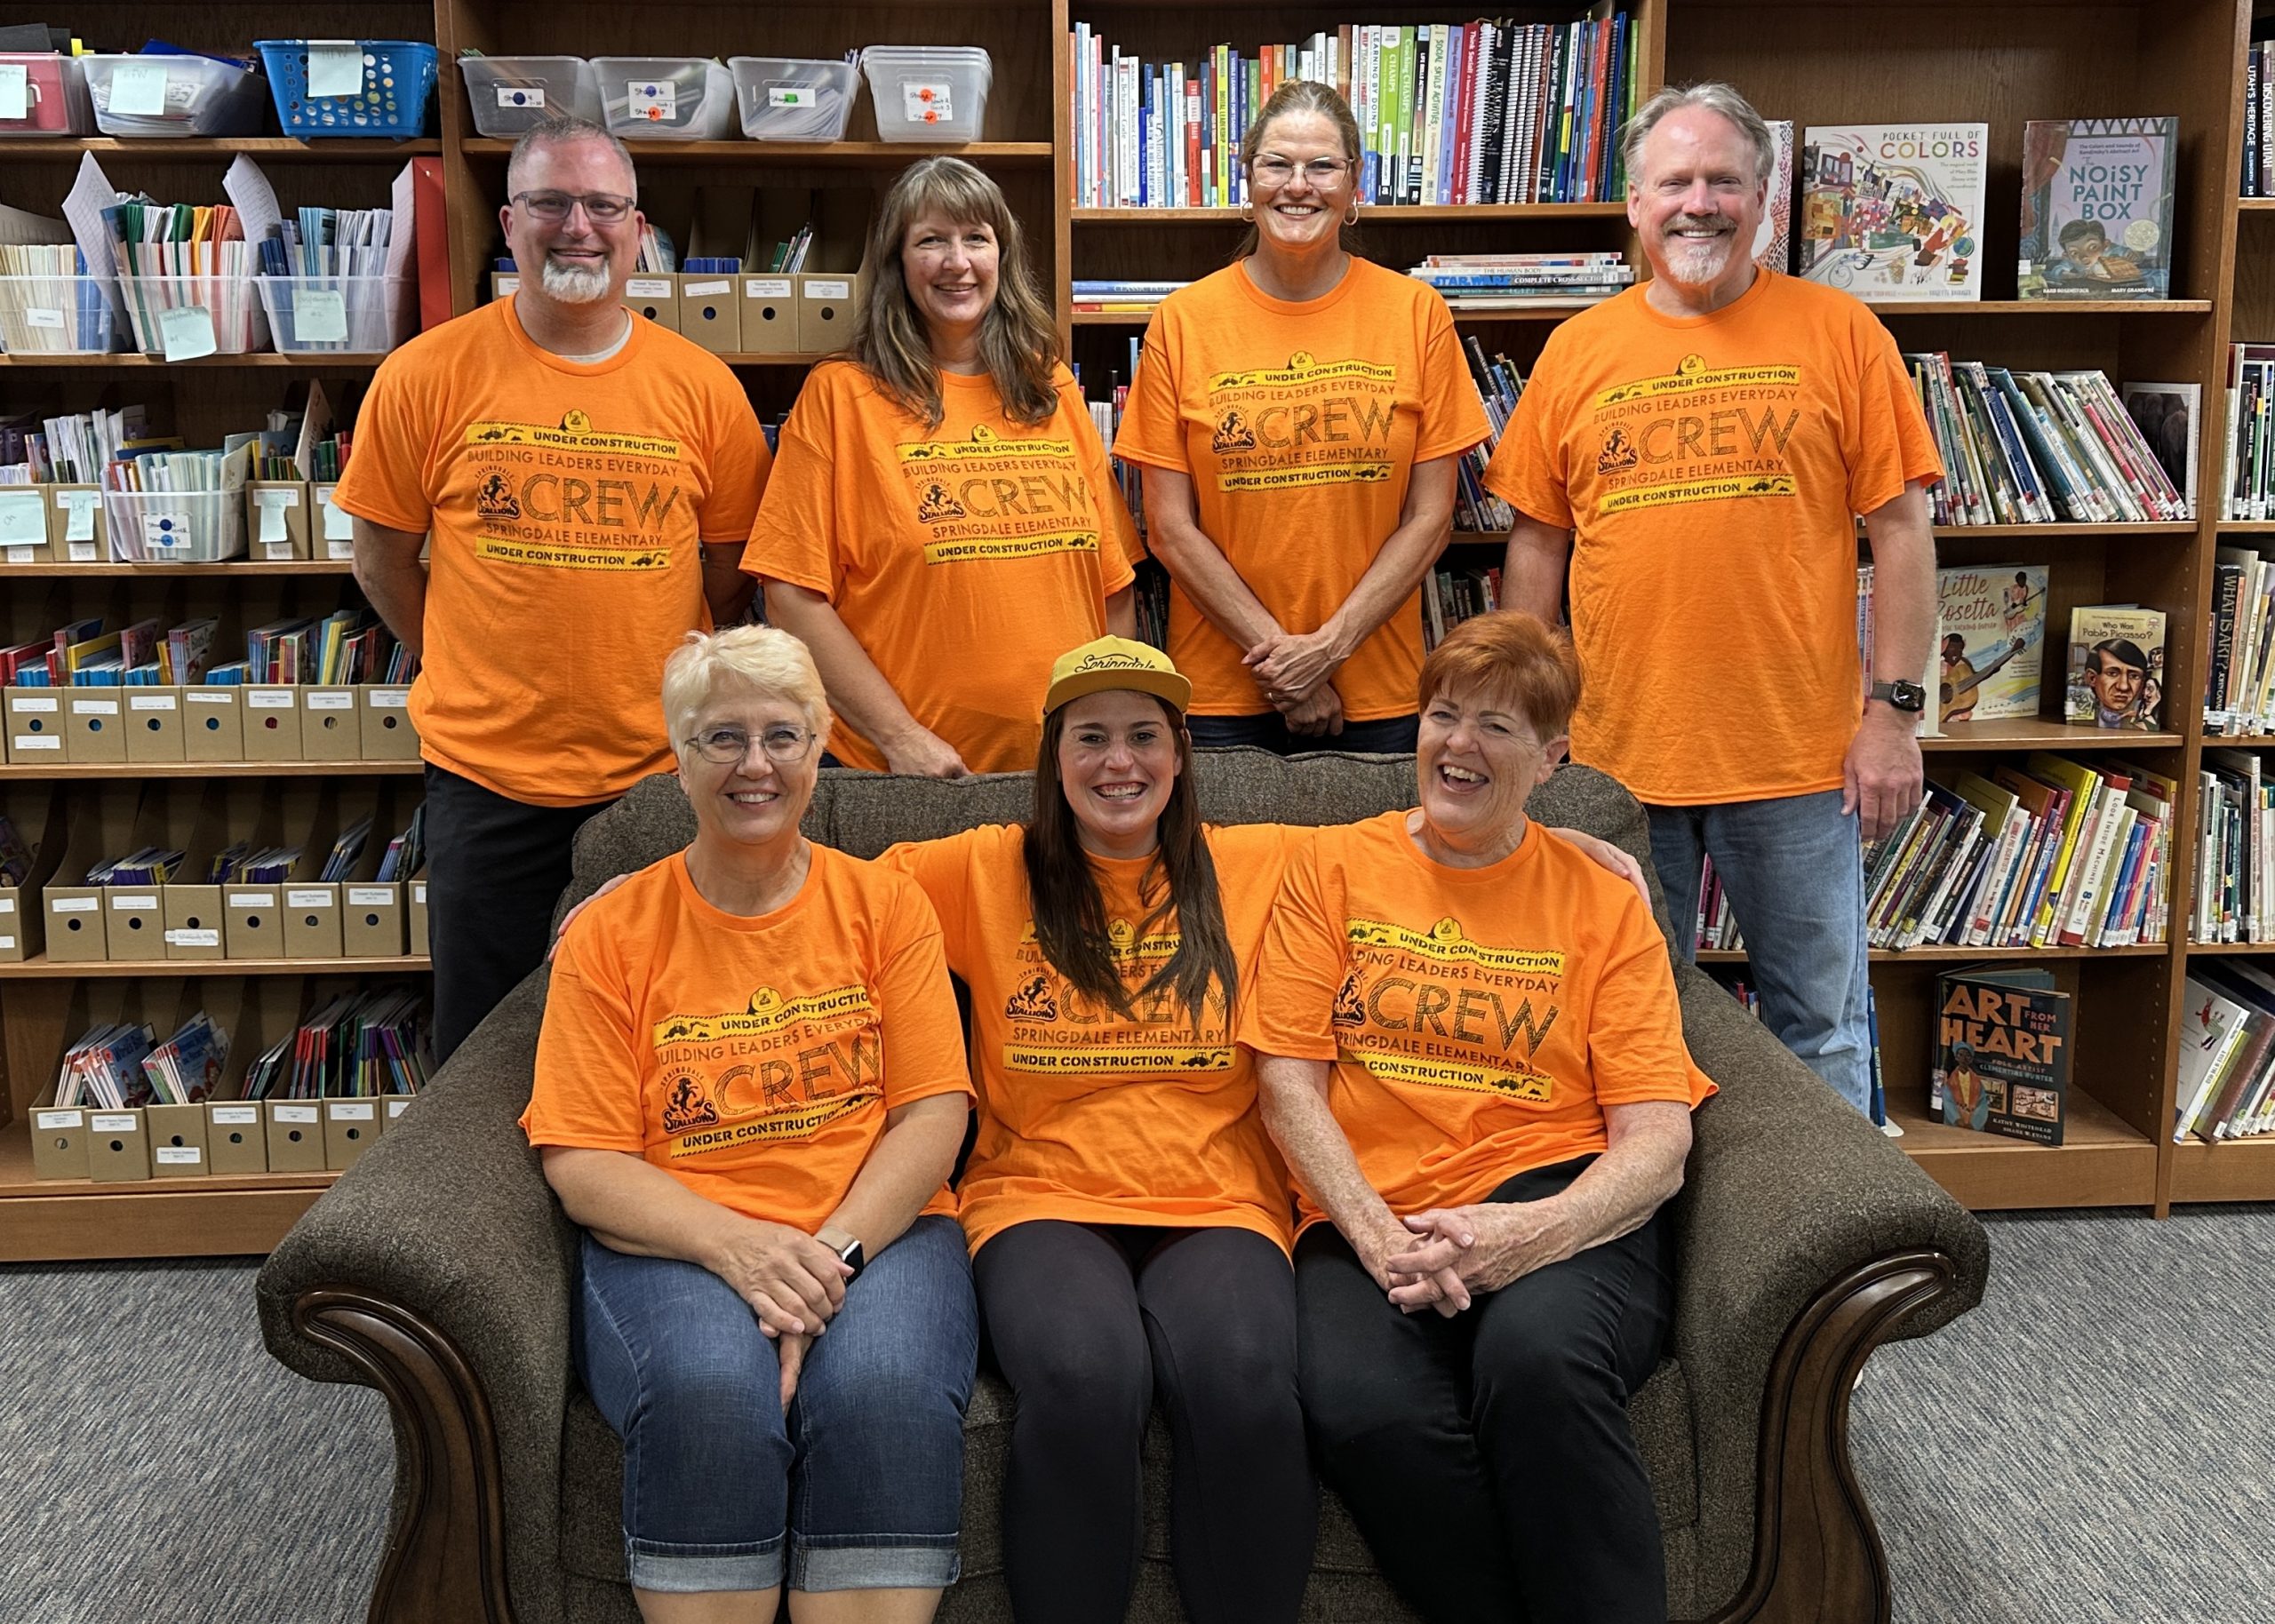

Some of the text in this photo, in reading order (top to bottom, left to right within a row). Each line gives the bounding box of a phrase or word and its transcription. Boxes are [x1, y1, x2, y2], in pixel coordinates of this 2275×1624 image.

[1466, 30, 1477, 74] Think Social!
[1551, 34, 1562, 68] The Tough
[1316, 51, 1325, 77] explicit
[1387, 53, 1397, 93] CHAMPS
[1401, 38, 1412, 114] Coaching CHAMPS
[1371, 82, 1378, 94] BY
[1431, 39, 1443, 125] SOCIAL SKILLS ACTIVITIES
[1492, 80, 1504, 134] TEACHER'S
[2247, 65, 2256, 147] UTAH'S HERITAGE
[1882, 130, 1982, 141] POCKET FULL OF
[2262, 82, 2273, 168] DISCOVERING UTAH
[1880, 140, 1979, 160] COLORS
[2072, 183, 2143, 203] PAINT
[2081, 202, 2132, 220] BOX
[1432, 275, 1552, 286] STAR WARS COMPLETE
[1265, 363, 1393, 382] UNDER CONSTRUCTION
[1651, 370, 1797, 391] UNDER CONSTRUCTION
[1209, 380, 1396, 408] BUILDING LEADERS EVERYDAY
[1592, 389, 1799, 425] BUILDING LEADERS EVERYDAY
[1255, 396, 1400, 449] CREW
[1638, 404, 1800, 465] CREW
[533, 431, 677, 456] UNDER CONSTRUCTION
[954, 443, 1070, 455] UNDER CONSTRUCTION
[1212, 429, 1257, 450] STALLIONS
[467, 449, 678, 478] BUILDING LEADERS EVERYDAY
[902, 459, 1078, 479] BUILDING LEADERS EVERYDAY
[1221, 448, 1389, 470] SPRINGDALE ELEMENTARY
[1598, 448, 1637, 474] STALLIONS
[1225, 469, 1351, 488] UNDER CONSTRUCTION
[1608, 459, 1784, 491] SPRINGDALE ELEMENTARY
[520, 473, 681, 532] CREW
[959, 472, 1088, 518] CREW
[1607, 482, 1742, 509] UNDER CONSTRUCTION
[918, 501, 965, 521] STALLIONS
[485, 521, 663, 547] SPRINGDALE ELEMENTARY
[932, 516, 1092, 539] SPRINGDALE ELEMENTARY
[486, 544, 626, 566] UNDER CONSTRUCTION
[937, 537, 1064, 558] UNDER CONSTRUCTION
[1939, 575, 1990, 599] Little
[2102, 622, 2135, 631] Who Was
[2215, 575, 2238, 689] WHAT IS JOHN
[2249, 613, 2258, 628] PAUL
[2082, 627, 2153, 641] Pablo Picasso?
[1998, 848, 2014, 874] SCIENTISTS
[2081, 889, 2094, 901] 8
[1399, 932, 1561, 968] UNDER CONSTRUCTION
[1398, 955, 1469, 979] LEADERS
[1473, 969, 1560, 996] EVERYDAY
[1005, 997, 1057, 1020] STALLIONS
[1941, 983, 2057, 1027] ART FROM
[721, 1017, 770, 1031] UNDER
[1367, 976, 1560, 1059] CREW
[2030, 1021, 2052, 1032] HER
[730, 1029, 801, 1057] LEADERS
[1012, 1027, 1225, 1045] SPRINGDALE ELEMENTARY
[1940, 1016, 2063, 1064] HEART
[1012, 1053, 1174, 1067] UNDER CONSTRUCTION
[1425, 1042, 1534, 1073] ELEMENTARY
[1992, 1058, 2047, 1074] FOLK ARTIST
[713, 1028, 882, 1116] CREW
[1368, 1060, 1484, 1084] CONSTRUCTION
[1979, 1063, 2055, 1083] CLEMENTINE HUNTER
[663, 1101, 718, 1132] STALLIONS
[1992, 1117, 2052, 1134] KATHY WHITEHEAD
[682, 1131, 732, 1149] UNDER
[2032, 1132, 2052, 1141] EVANS
